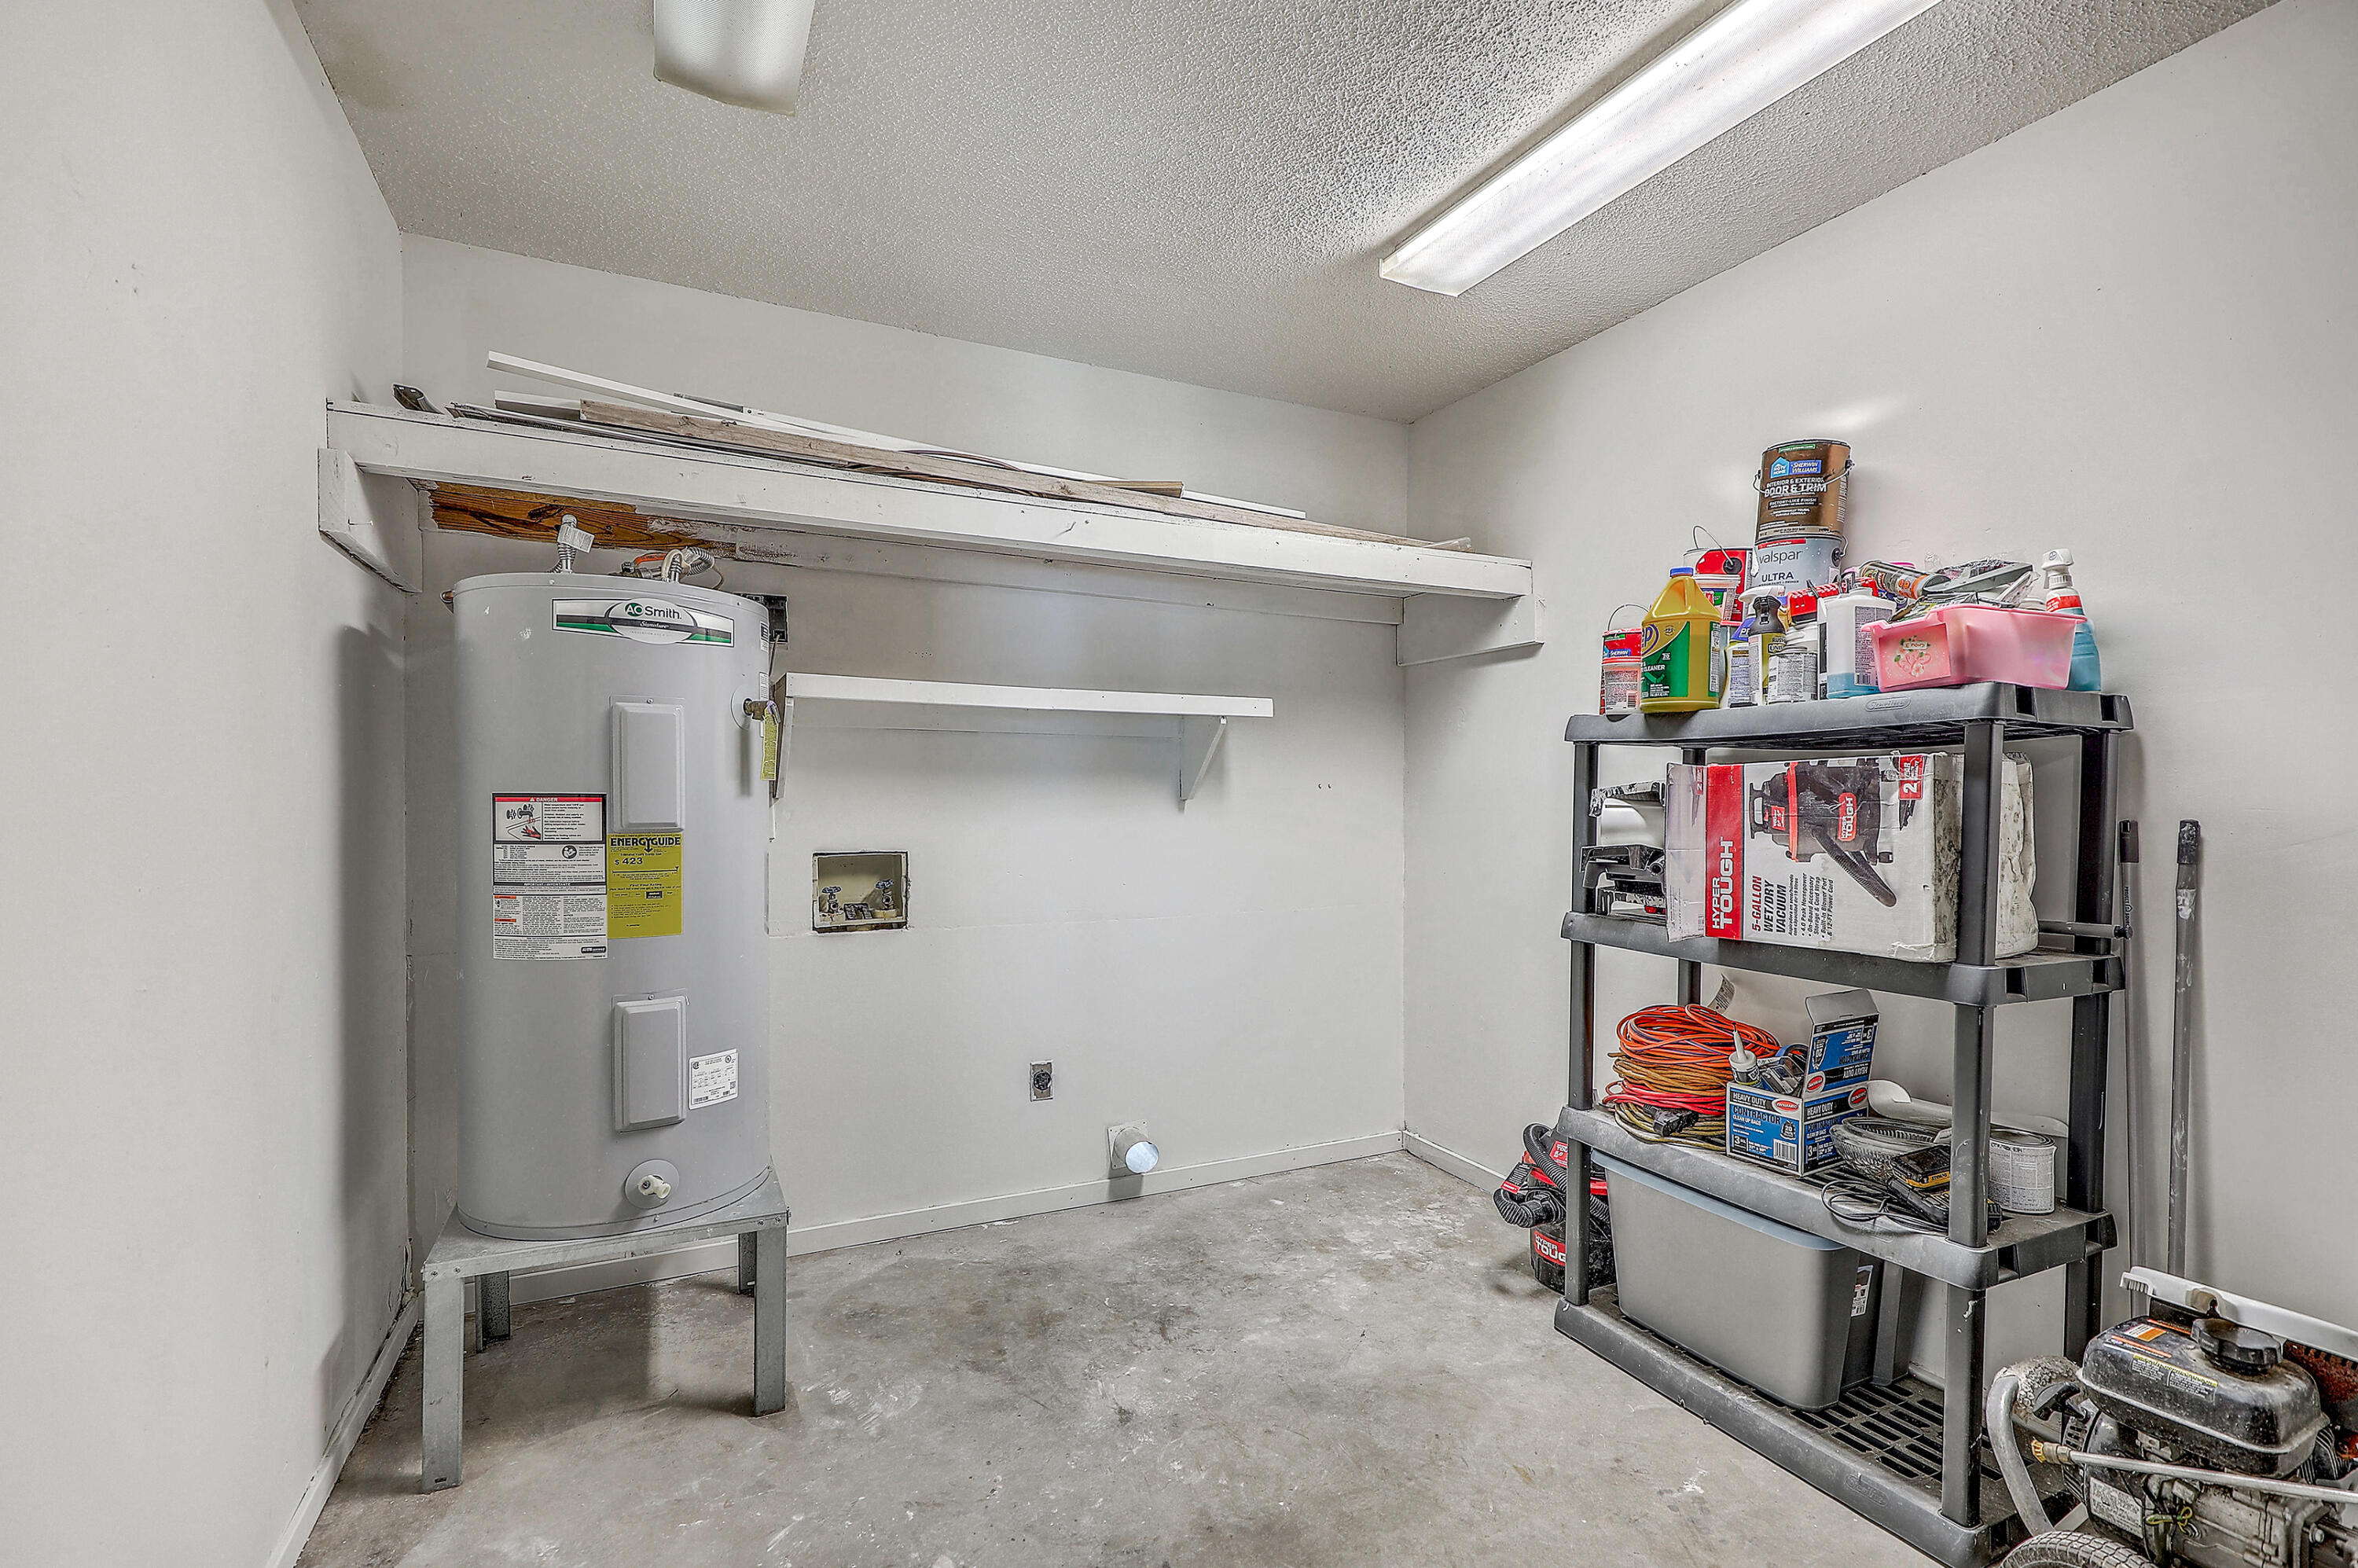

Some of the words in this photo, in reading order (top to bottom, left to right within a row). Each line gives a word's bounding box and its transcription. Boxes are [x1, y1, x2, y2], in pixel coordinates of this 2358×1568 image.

[1765, 485, 1789, 498] DOOR
[1799, 483, 1827, 492] TRIM
[1767, 478, 1789, 488] INTERIOR
[1759, 550, 1802, 564] valspar
[1761, 571, 1794, 582] ULTRA
[1904, 782, 1919, 793] 2
[1845, 796, 1854, 837] TOUGH
[610, 836, 681, 848] ENERGYGUIDE
[622, 857, 643, 865] 423
[1719, 840, 1733, 930] TOUGH
[1712, 876, 1721, 929] HYPER
[1752, 875, 1762, 932] 5-GALLON
[1763, 879, 1775, 933] WET/DRY
[1776, 883, 1787, 934] VACUUM
[1867, 1029, 1872, 1039] 3
[1733, 1092, 1750, 1102] HEAVY
[1751, 1096, 1766, 1107] DUTY
[1733, 1106, 1781, 1125] CONTRACTOR
[1807, 1103, 1821, 1116] HEAVY
[1821, 1102, 1833, 1113] DUTY
[1734, 1136, 1740, 1144] 3
[1808, 1145, 1813, 1157] 3
[1536, 1234, 1558, 1251] HYPER
[1536, 1241, 1566, 1262] TOUG
